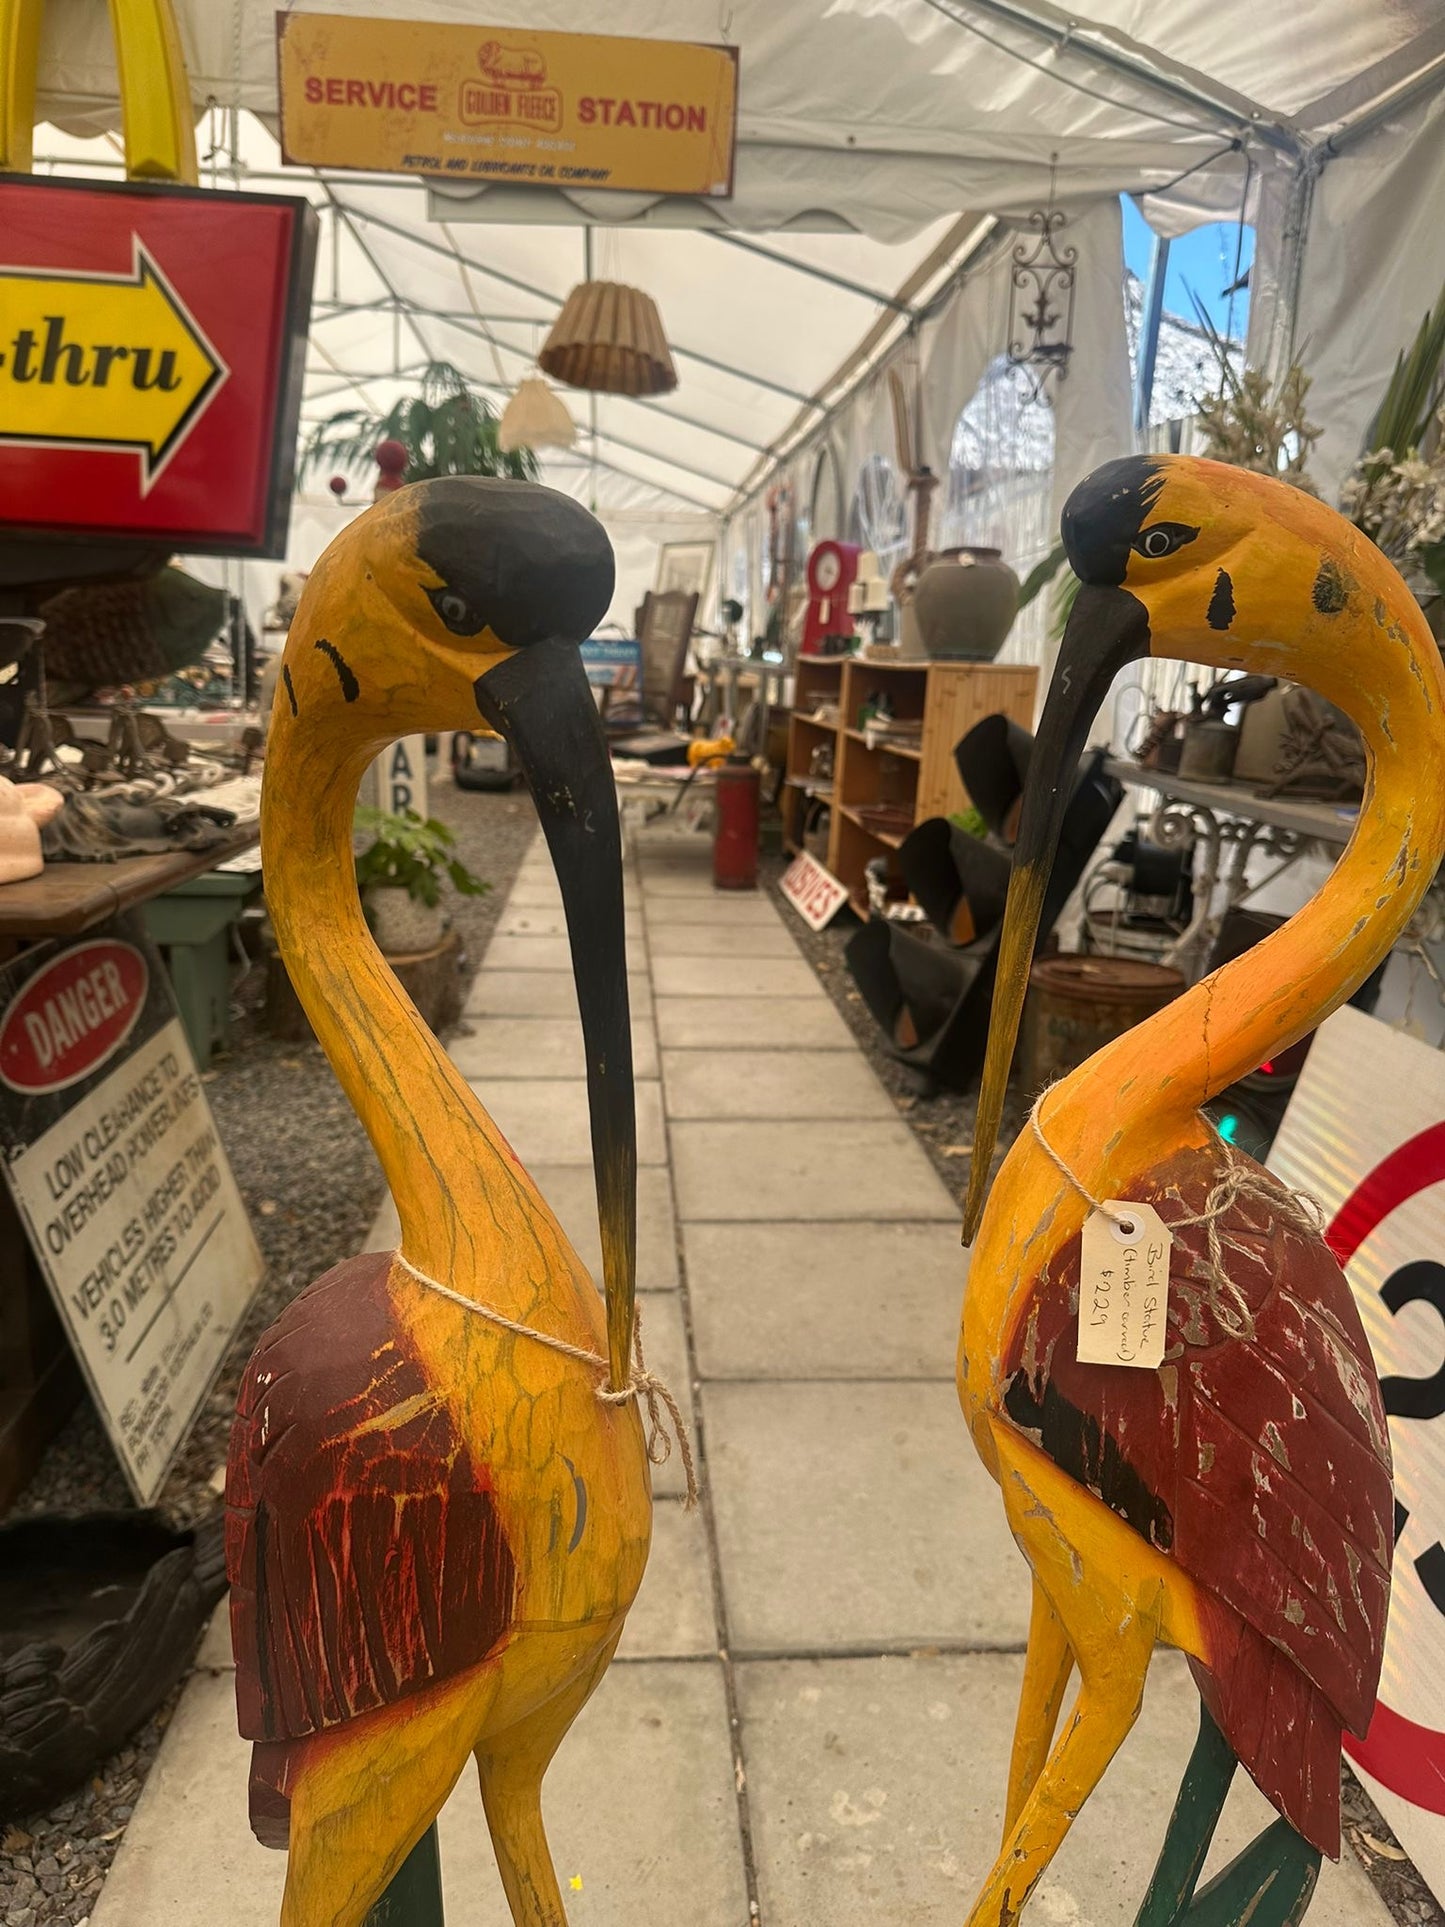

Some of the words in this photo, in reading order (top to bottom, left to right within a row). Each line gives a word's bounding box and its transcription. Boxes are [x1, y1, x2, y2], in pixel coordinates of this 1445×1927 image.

[305, 76, 438, 112] SERVICE
[578, 97, 706, 132] STATION
[24, 960, 129, 1068] DANGER
[44, 1143, 85, 1201] LOW
[83, 1069, 164, 1161] CLEARANCE
[160, 1052, 180, 1091] TO
[45, 1152, 128, 1255] OVERHEAD
[72, 1217, 145, 1320] VEHICLES
[142, 1161, 190, 1232] HIGHER
[122, 1224, 177, 1313] METRES
[173, 1202, 194, 1238] TO
[1090, 1270, 1115, 1326] $229
[1146, 1242, 1163, 1287] Bird
[1140, 1297, 1157, 1349] Statue
